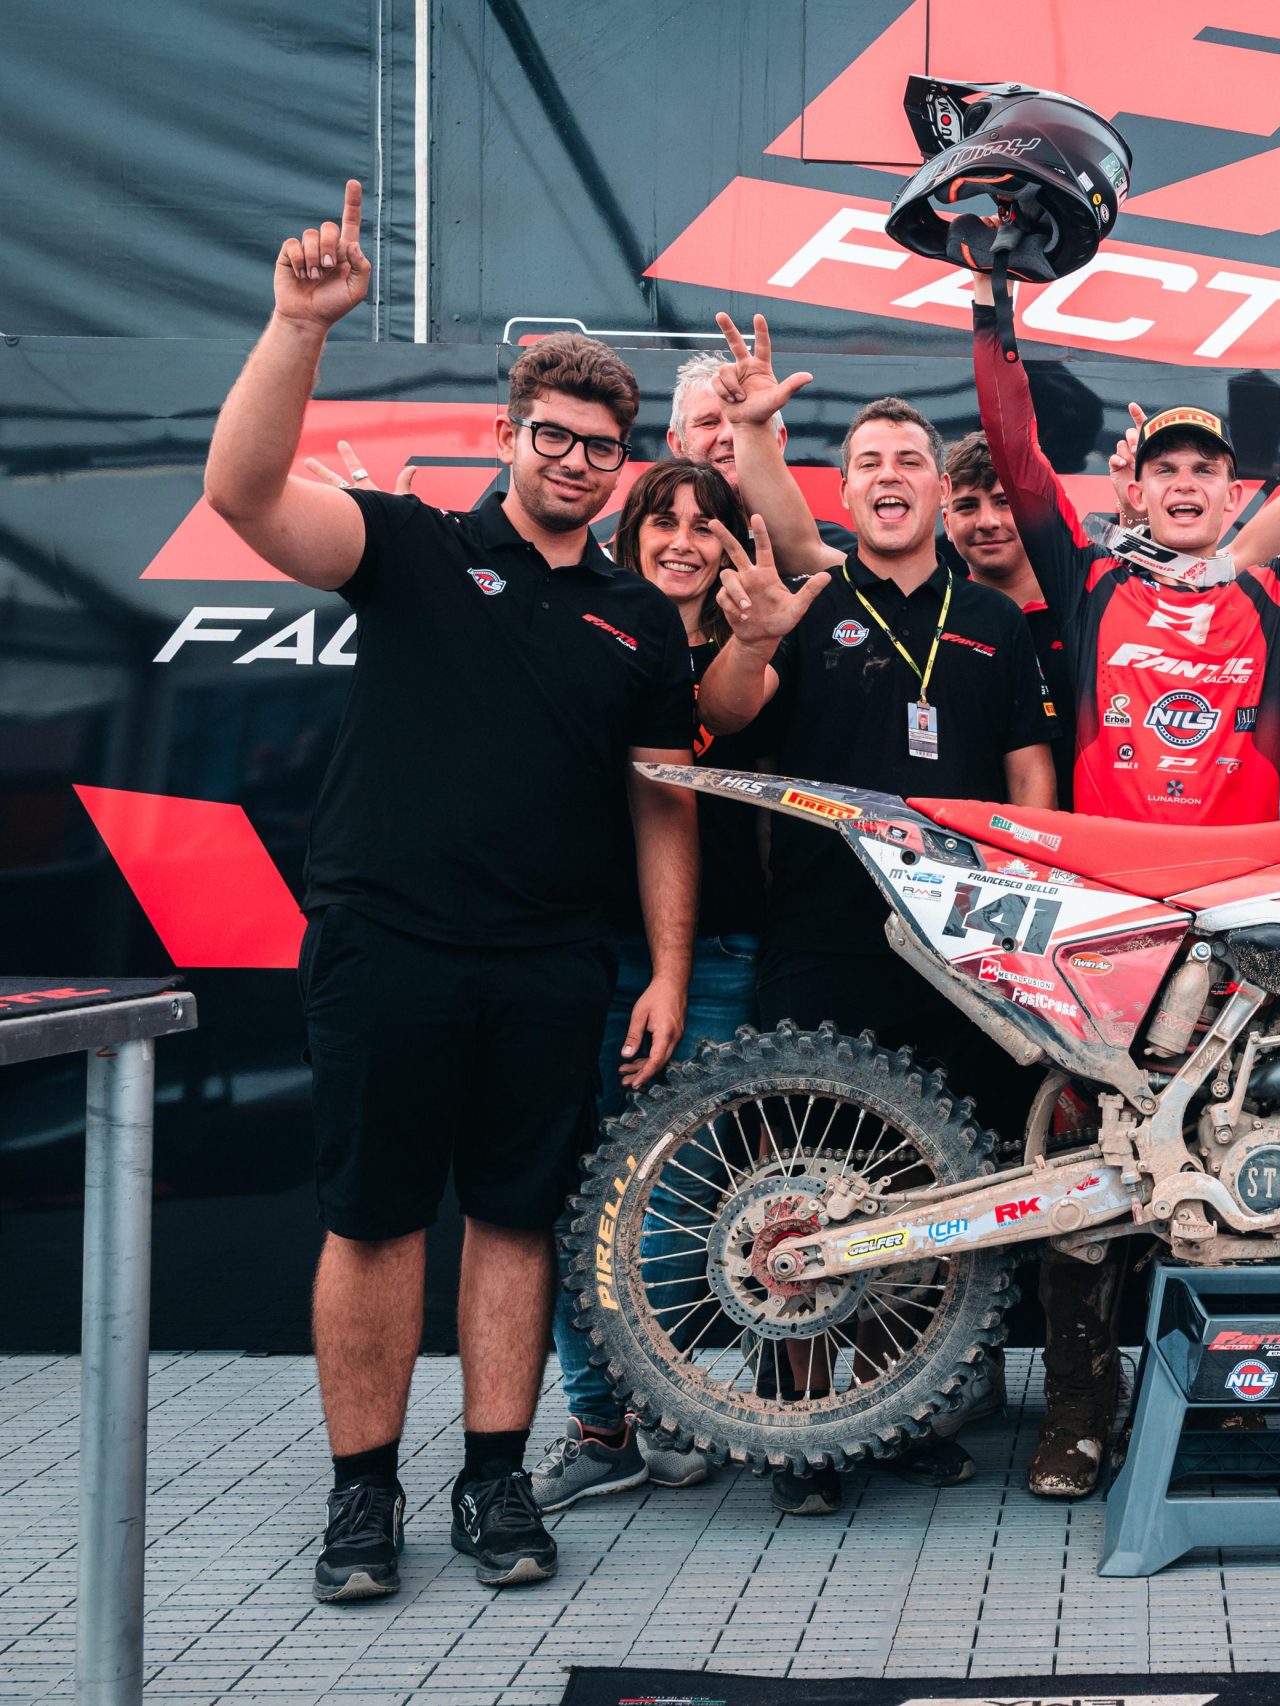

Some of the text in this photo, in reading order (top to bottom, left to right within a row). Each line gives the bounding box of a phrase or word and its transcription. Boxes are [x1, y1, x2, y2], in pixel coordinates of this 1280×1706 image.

[1149, 409, 1217, 434] PIRELLI
[475, 575, 503, 591] ILS
[834, 629, 868, 638] NILS
[940, 632, 996, 655] FANTIC
[1107, 643, 1254, 679] FANTIC
[1105, 714, 1131, 725] Erbea
[1149, 706, 1217, 731] NILS
[720, 776, 768, 794] HGS
[788, 791, 859, 820] PIRELLI
[1147, 794, 1202, 805] LUNARDON
[903, 886, 942, 898] RMS
[968, 872, 1022, 889] FRANCESCO
[1024, 883, 1059, 895] BELLEI
[942, 881, 1062, 957] 141
[1073, 957, 1111, 970] Twin Air
[998, 971, 1054, 990] METALFUSIONI
[1011, 986, 1077, 1017] FastCross
[994, 1196, 1041, 1223] RK
[596, 1154, 638, 1310] PIRELLI
[1227, 1373, 1277, 1388] NILS
